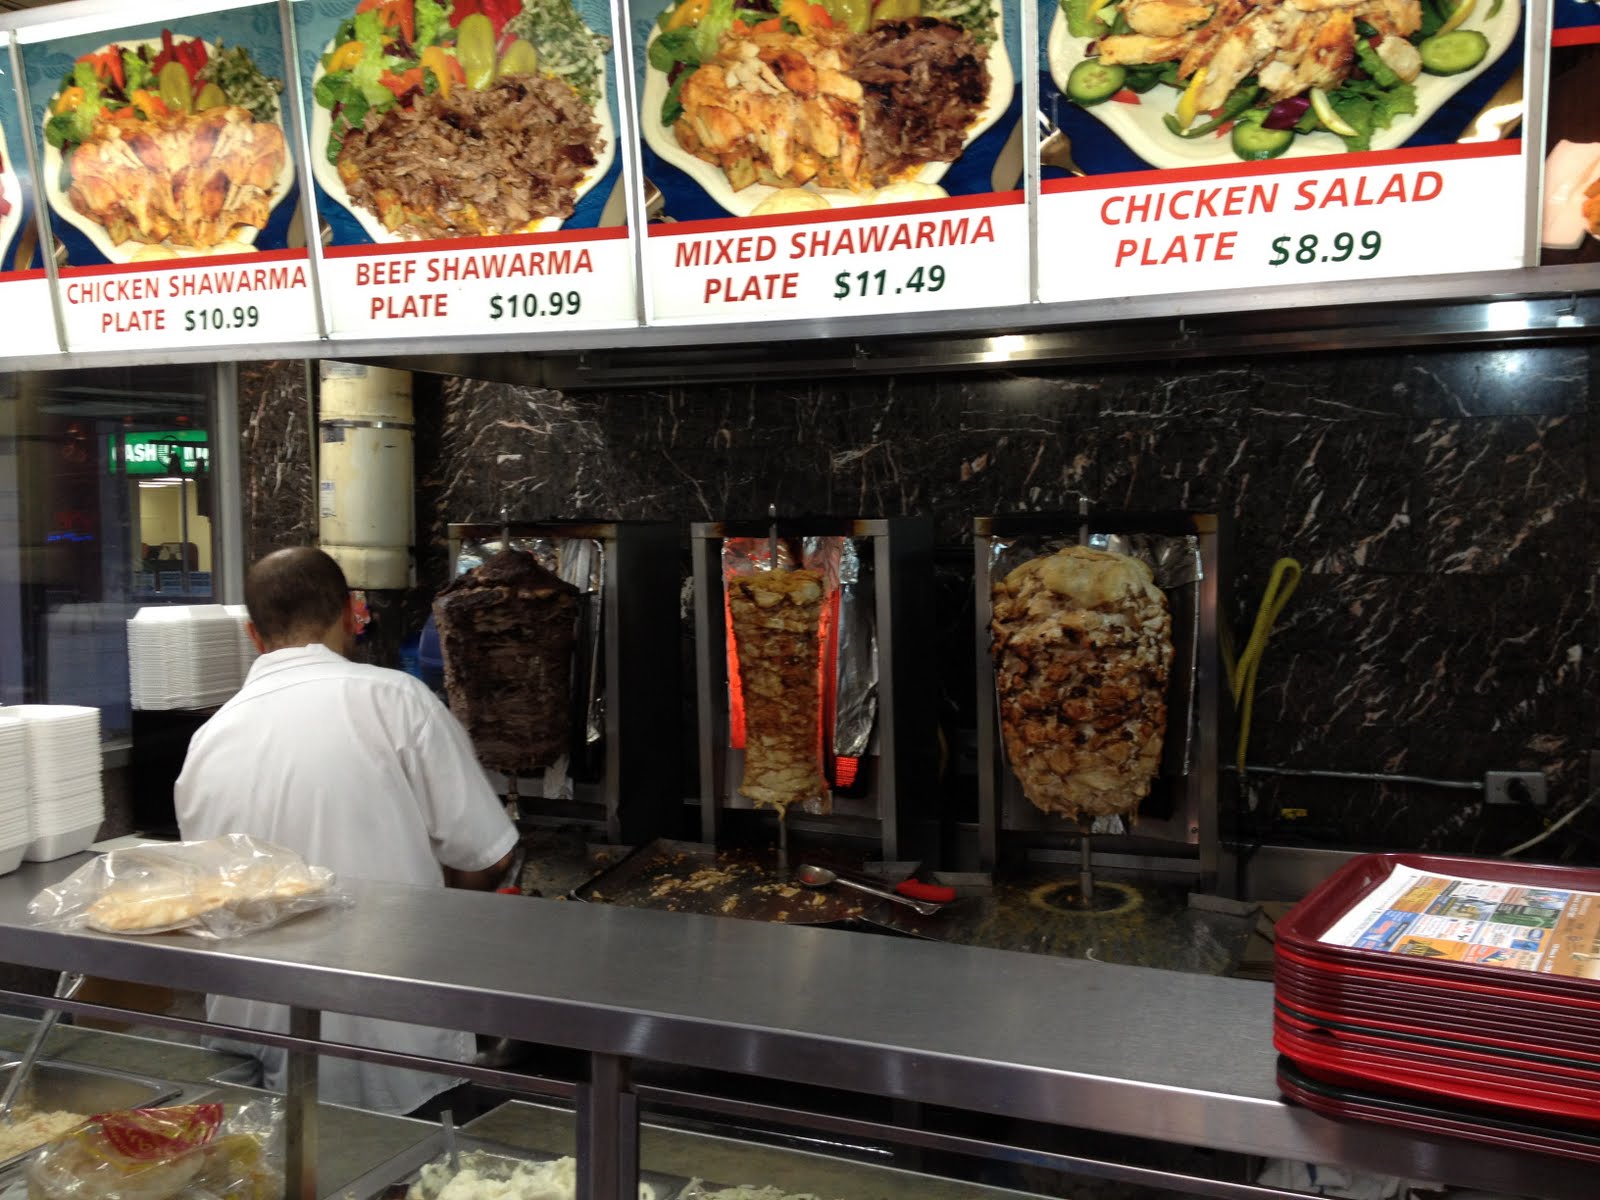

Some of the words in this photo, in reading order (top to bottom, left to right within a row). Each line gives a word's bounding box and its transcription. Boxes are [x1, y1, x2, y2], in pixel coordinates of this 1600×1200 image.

[1101, 183, 1279, 225] CHICKEN
[1295, 171, 1443, 210] SALAD
[676, 236, 777, 267] MIXED
[790, 216, 994, 259] SHAWARMA
[1115, 232, 1237, 267] PLATE
[1269, 231, 1381, 266] $8.99
[68, 277, 159, 304] CHICKEN
[170, 266, 307, 297] SHAWARMA
[357, 260, 416, 285] BEEF
[427, 249, 592, 282] SHAWARMA
[704, 273, 798, 303] PLATE
[834, 265, 945, 299] $11.49
[103, 310, 165, 333] PLATE
[185, 306, 258, 331] $10.99
[371, 294, 447, 319] PLATE
[490, 291, 580, 319] $10.99
